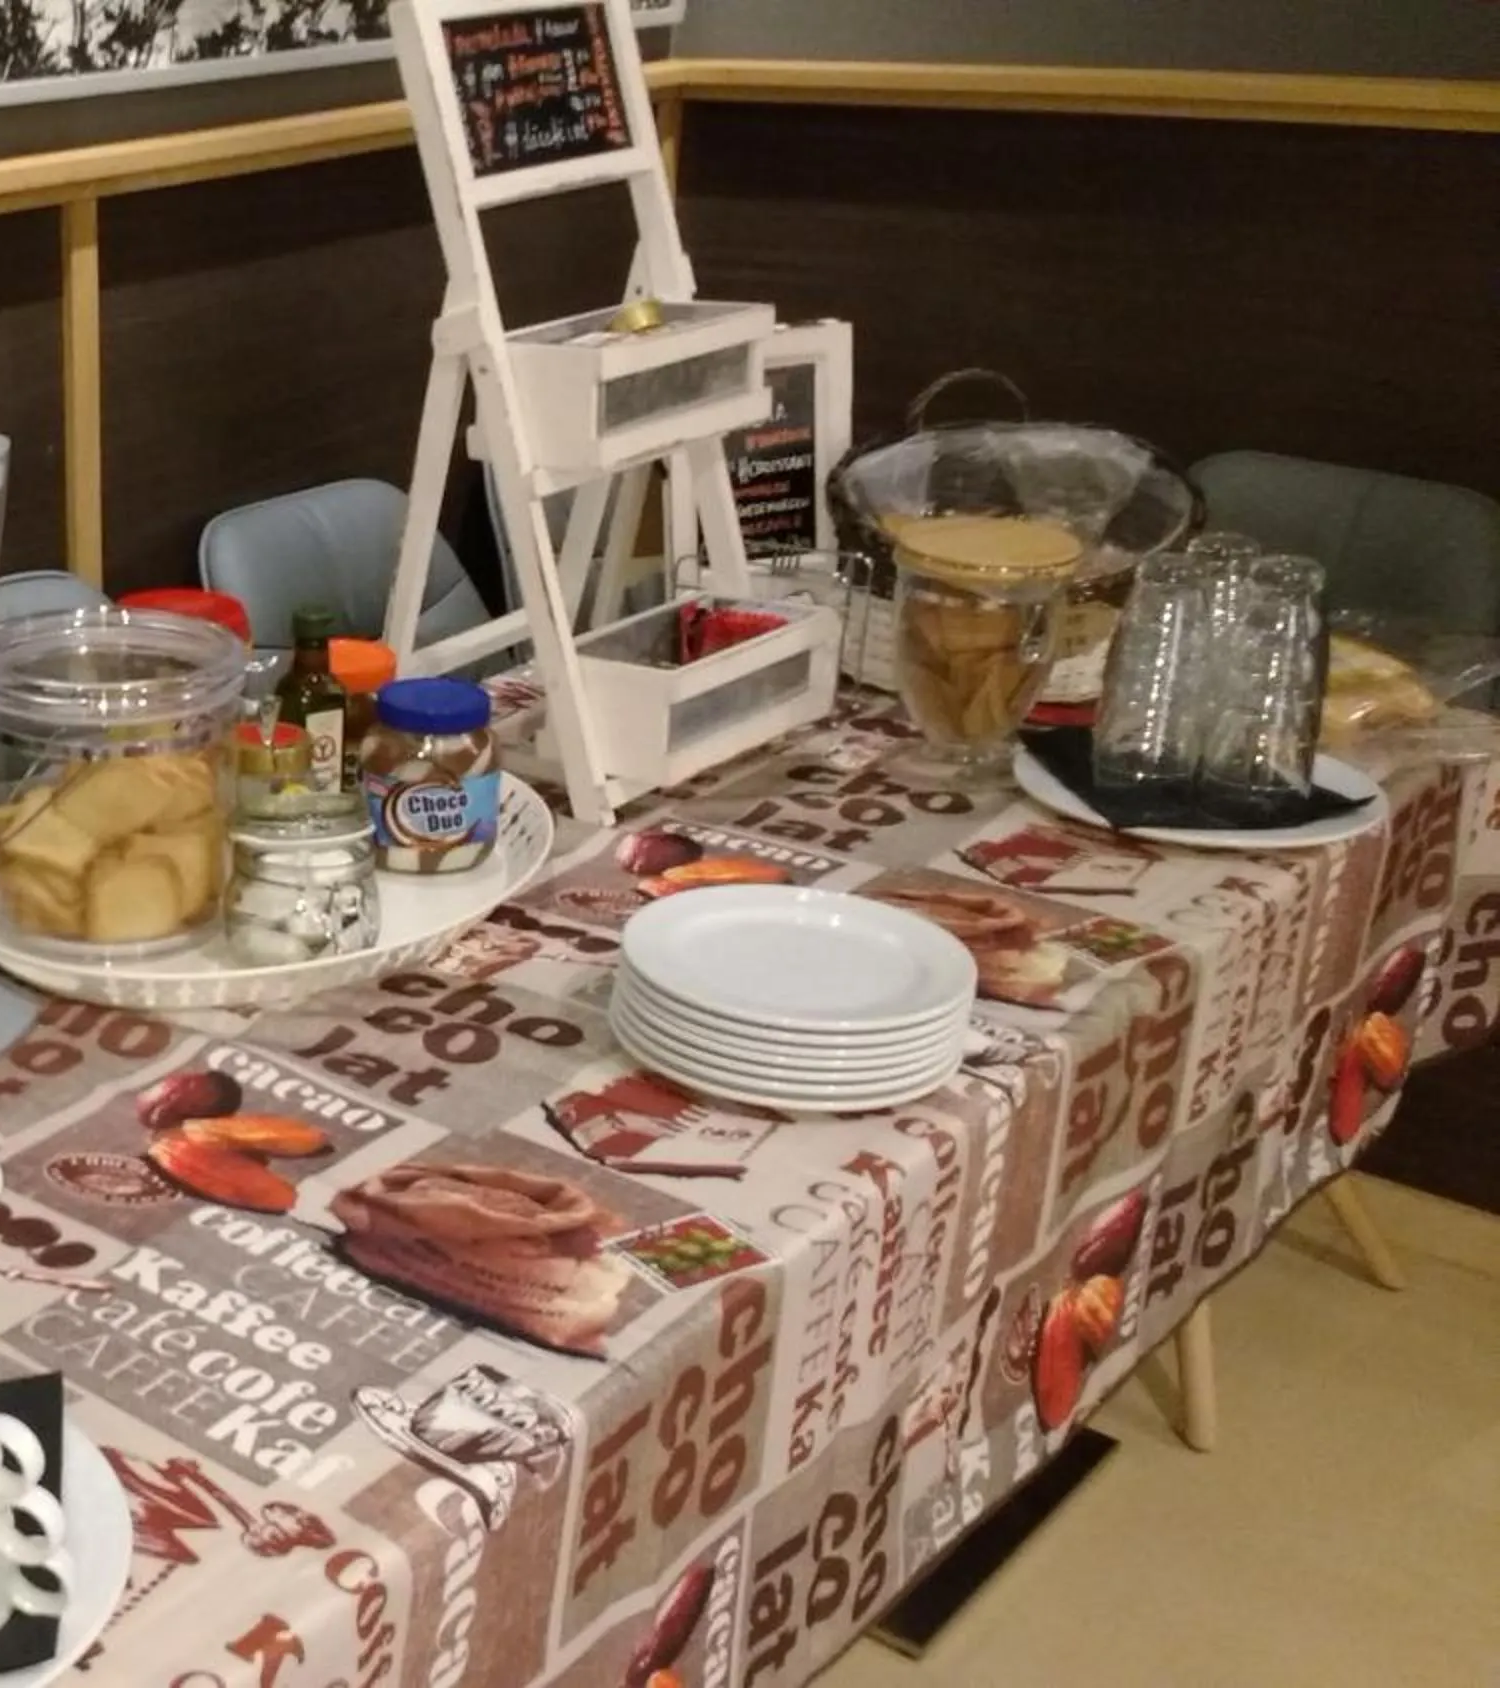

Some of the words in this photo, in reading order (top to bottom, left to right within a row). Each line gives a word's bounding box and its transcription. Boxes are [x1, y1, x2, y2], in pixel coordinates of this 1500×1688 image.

[407, 793, 468, 814] Choco
[427, 814, 464, 833] Duo
[732, 801, 872, 851] lat
[362, 1006, 501, 1064] co
[378, 973, 584, 1047] cho
[204, 1042, 389, 1134] cacao
[289, 1024, 452, 1106] lat
[111, 1246, 333, 1370] Kaffee
[699, 1276, 773, 1518] cho
[651, 1365, 706, 1530] co
[573, 1402, 652, 1598] lat
